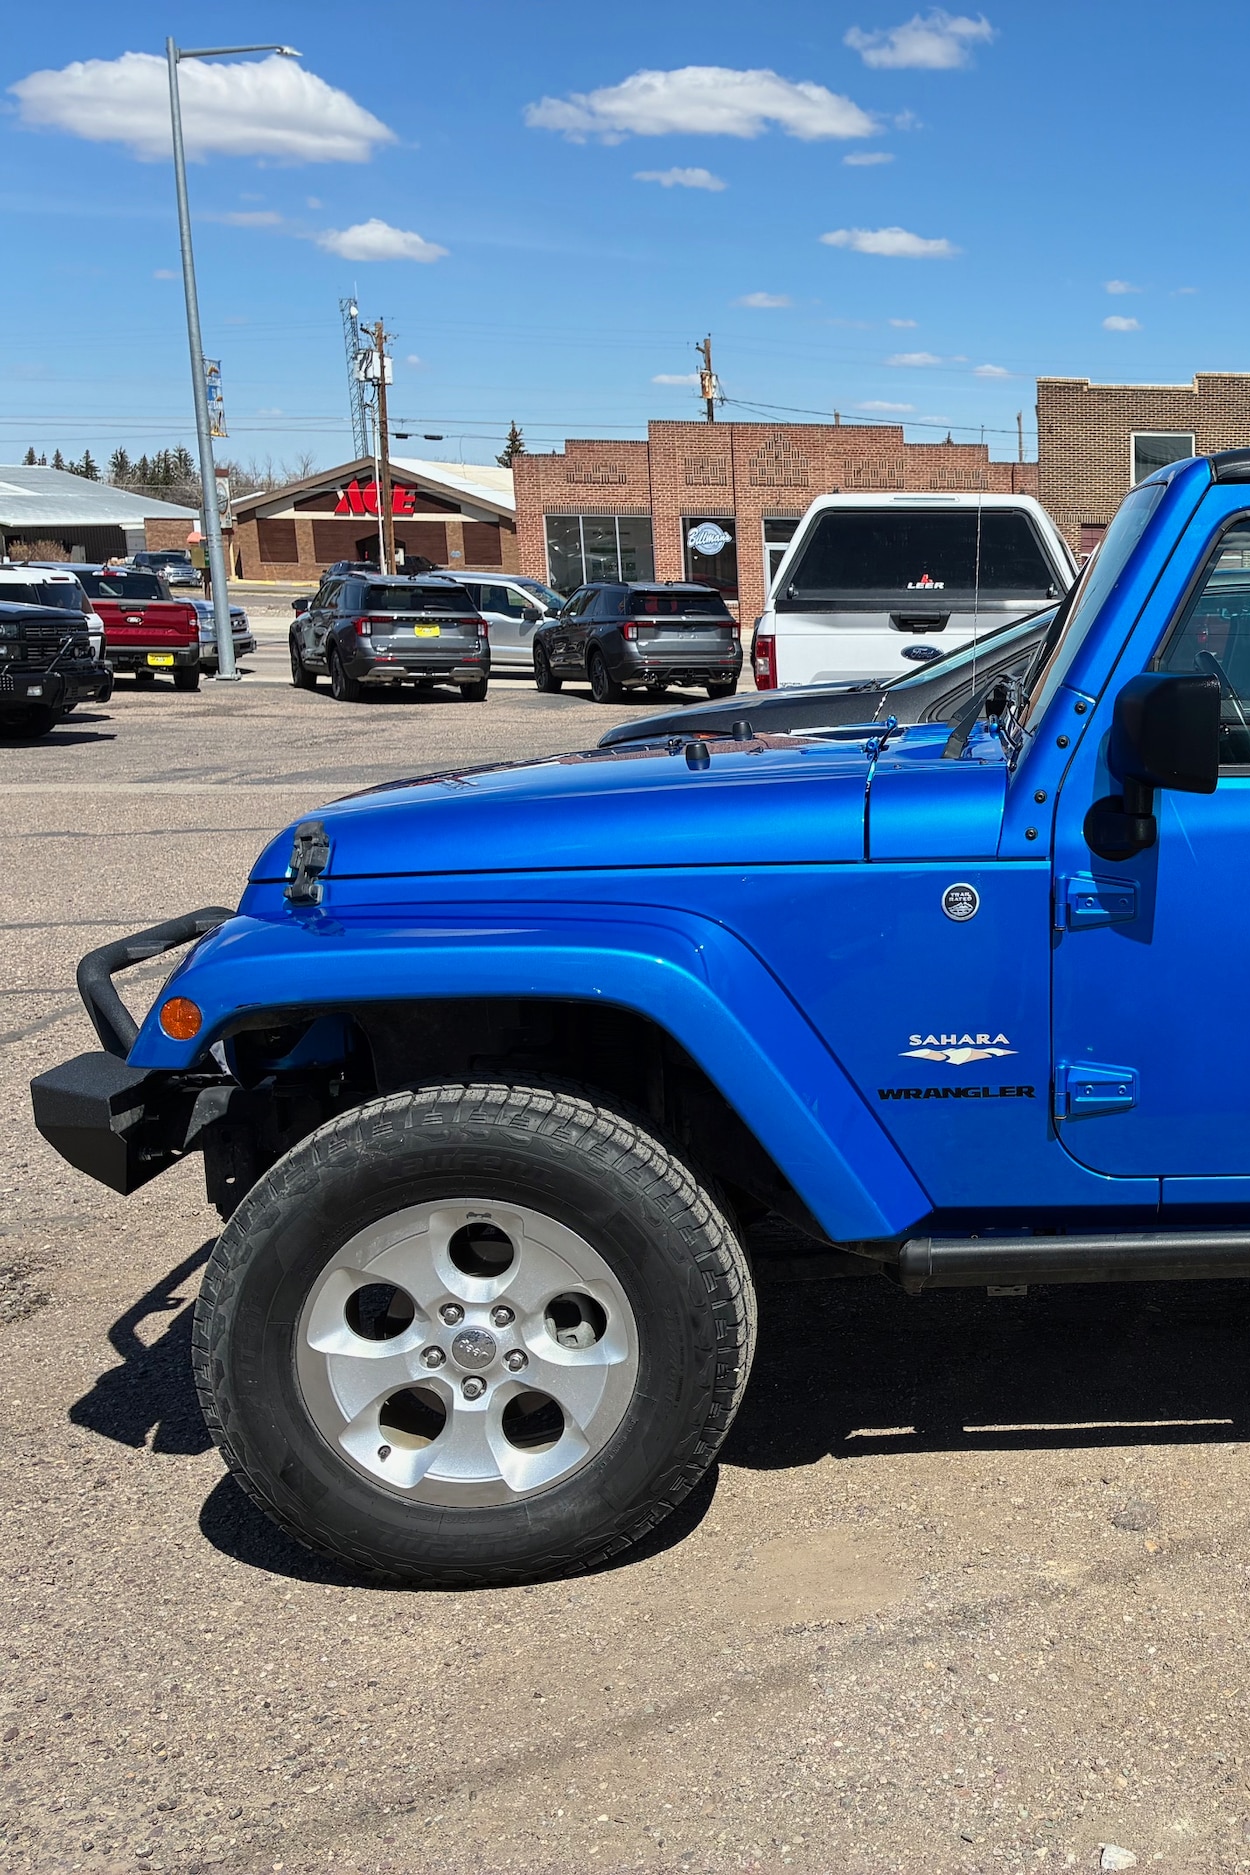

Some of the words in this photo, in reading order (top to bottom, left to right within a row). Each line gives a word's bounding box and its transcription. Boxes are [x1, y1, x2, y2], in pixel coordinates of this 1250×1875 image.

[334, 479, 416, 516] ACE
[907, 582, 945, 590] LEER
[909, 1033, 1010, 1046] SAHARA
[877, 1086, 1036, 1100] WRANGLER
